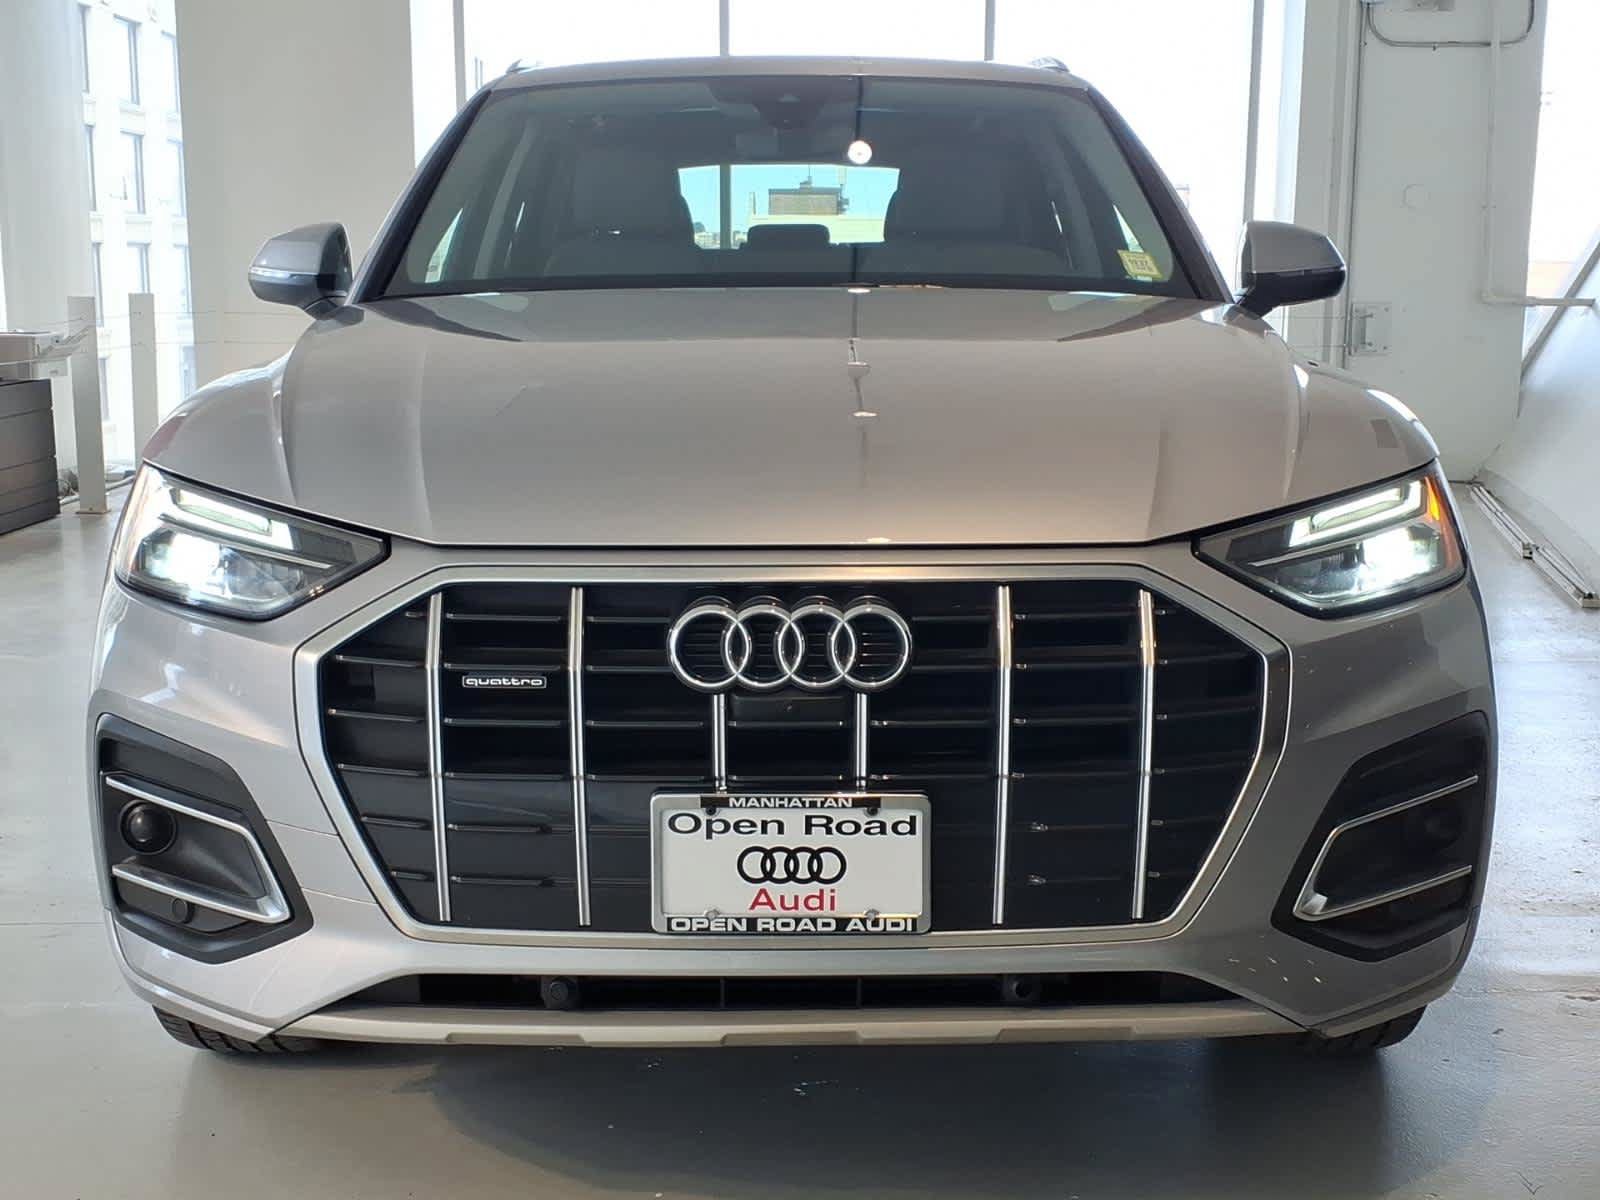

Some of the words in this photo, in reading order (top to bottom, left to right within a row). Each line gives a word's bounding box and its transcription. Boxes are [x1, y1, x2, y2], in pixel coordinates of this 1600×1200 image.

[466, 678, 542, 687] quattro
[729, 797, 852, 808] MANHATTAN
[668, 813, 785, 840] Open
[804, 815, 917, 836] Road
[749, 888, 836, 911] Audi
[670, 917, 747, 931] OPEN
[757, 917, 837, 931] ROAD
[845, 917, 912, 931] AUDI
